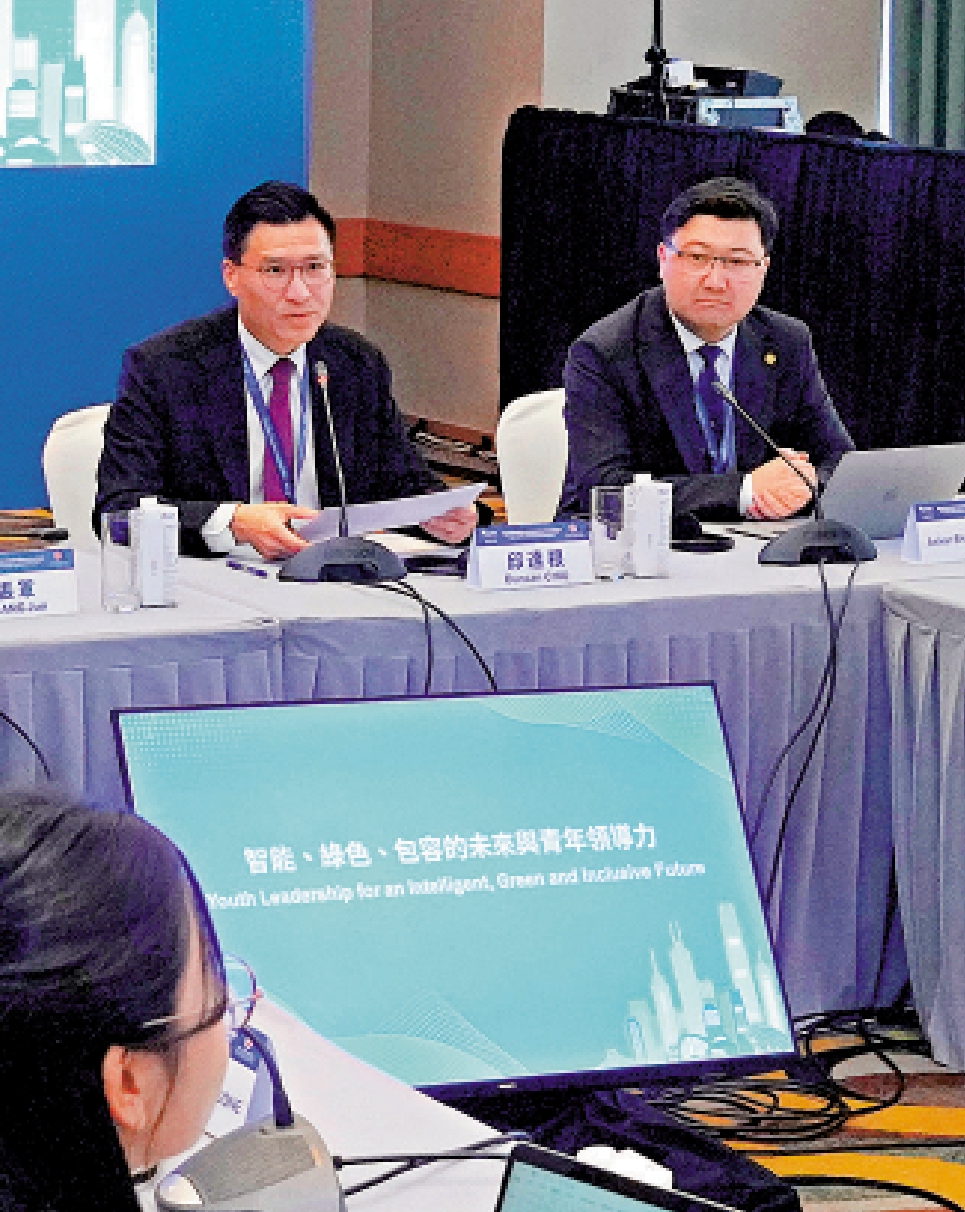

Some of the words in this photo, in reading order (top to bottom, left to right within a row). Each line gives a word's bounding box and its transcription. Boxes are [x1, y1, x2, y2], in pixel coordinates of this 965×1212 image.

[206, 890, 257, 909] Youth
[260, 883, 355, 906] Leadership
[356, 881, 382, 898] for
[385, 884, 405, 897] an
[496, 872, 545, 889] Green
[549, 867, 578, 886] and
[581, 863, 652, 883] Inclusive
[653, 860, 706, 877] Future
